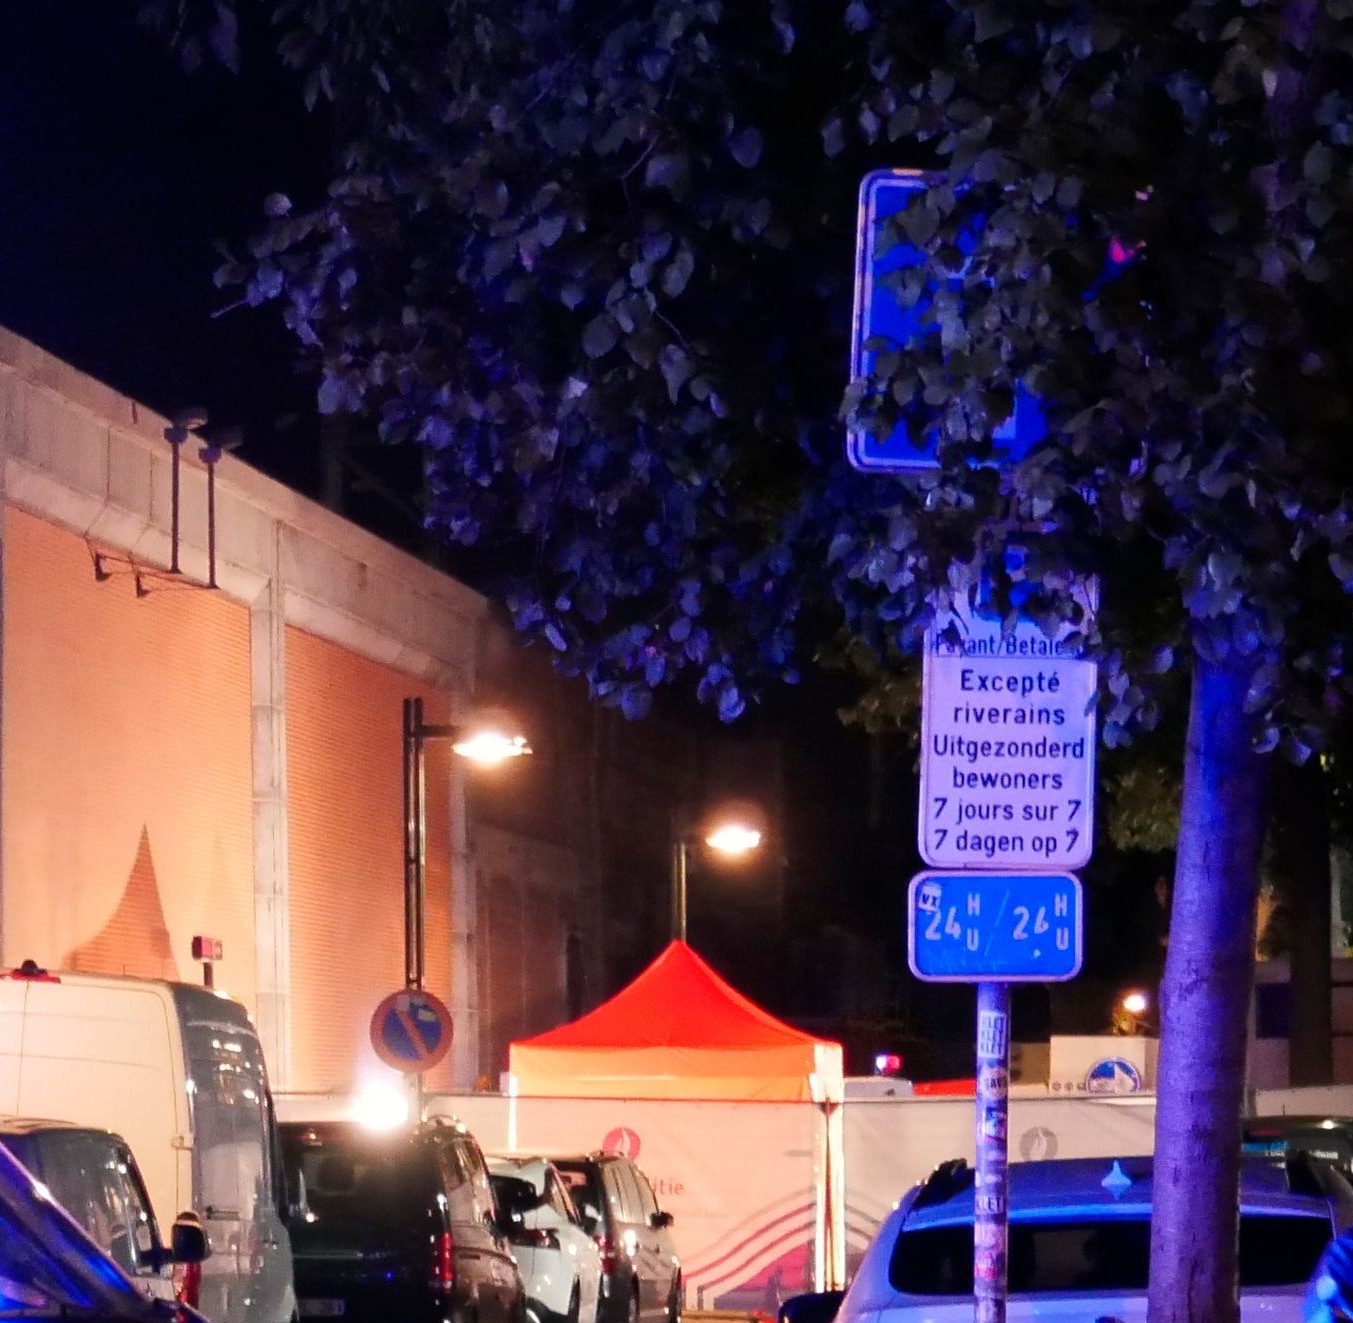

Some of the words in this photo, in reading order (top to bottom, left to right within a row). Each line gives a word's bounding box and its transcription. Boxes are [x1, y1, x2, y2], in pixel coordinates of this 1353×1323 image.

[960, 669, 1061, 697] Excepté
[953, 702, 1066, 725] riverains
[933, 735, 1085, 763] Uitgezonderd
[952, 767, 1064, 790] bewoners
[933, 798, 948, 820] 7
[955, 801, 1014, 824] jours
[1022, 804, 1059, 820] sur
[1067, 799, 1082, 821] 7
[933, 829, 948, 850] 7
[956, 831, 1024, 858] dagen
[1032, 834, 1058, 858] op
[1065, 828, 1079, 853] 7
[925, 906, 962, 941] 24
